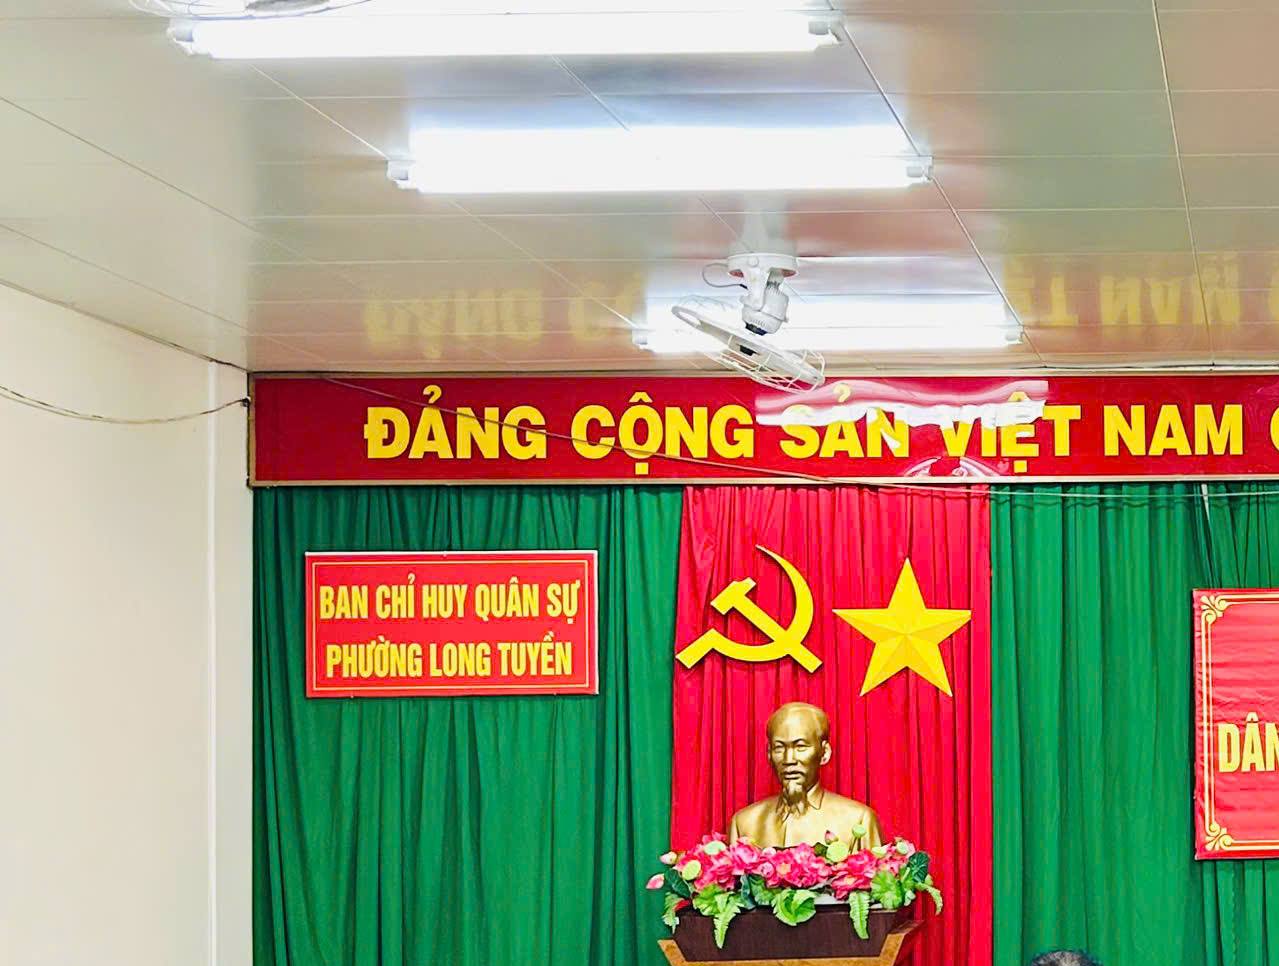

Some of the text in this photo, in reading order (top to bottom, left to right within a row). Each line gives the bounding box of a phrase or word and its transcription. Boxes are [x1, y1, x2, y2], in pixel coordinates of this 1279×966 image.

[364, 385, 547, 459] ĐẢNG
[571, 391, 754, 474] CỘNG
[1103, 405, 1243, 456] NAM
[319, 573, 581, 625] BAN CHỈ HUY QUÂN SỰ
[326, 630, 572, 678] PHƯỜNG LONG TUYỀN
